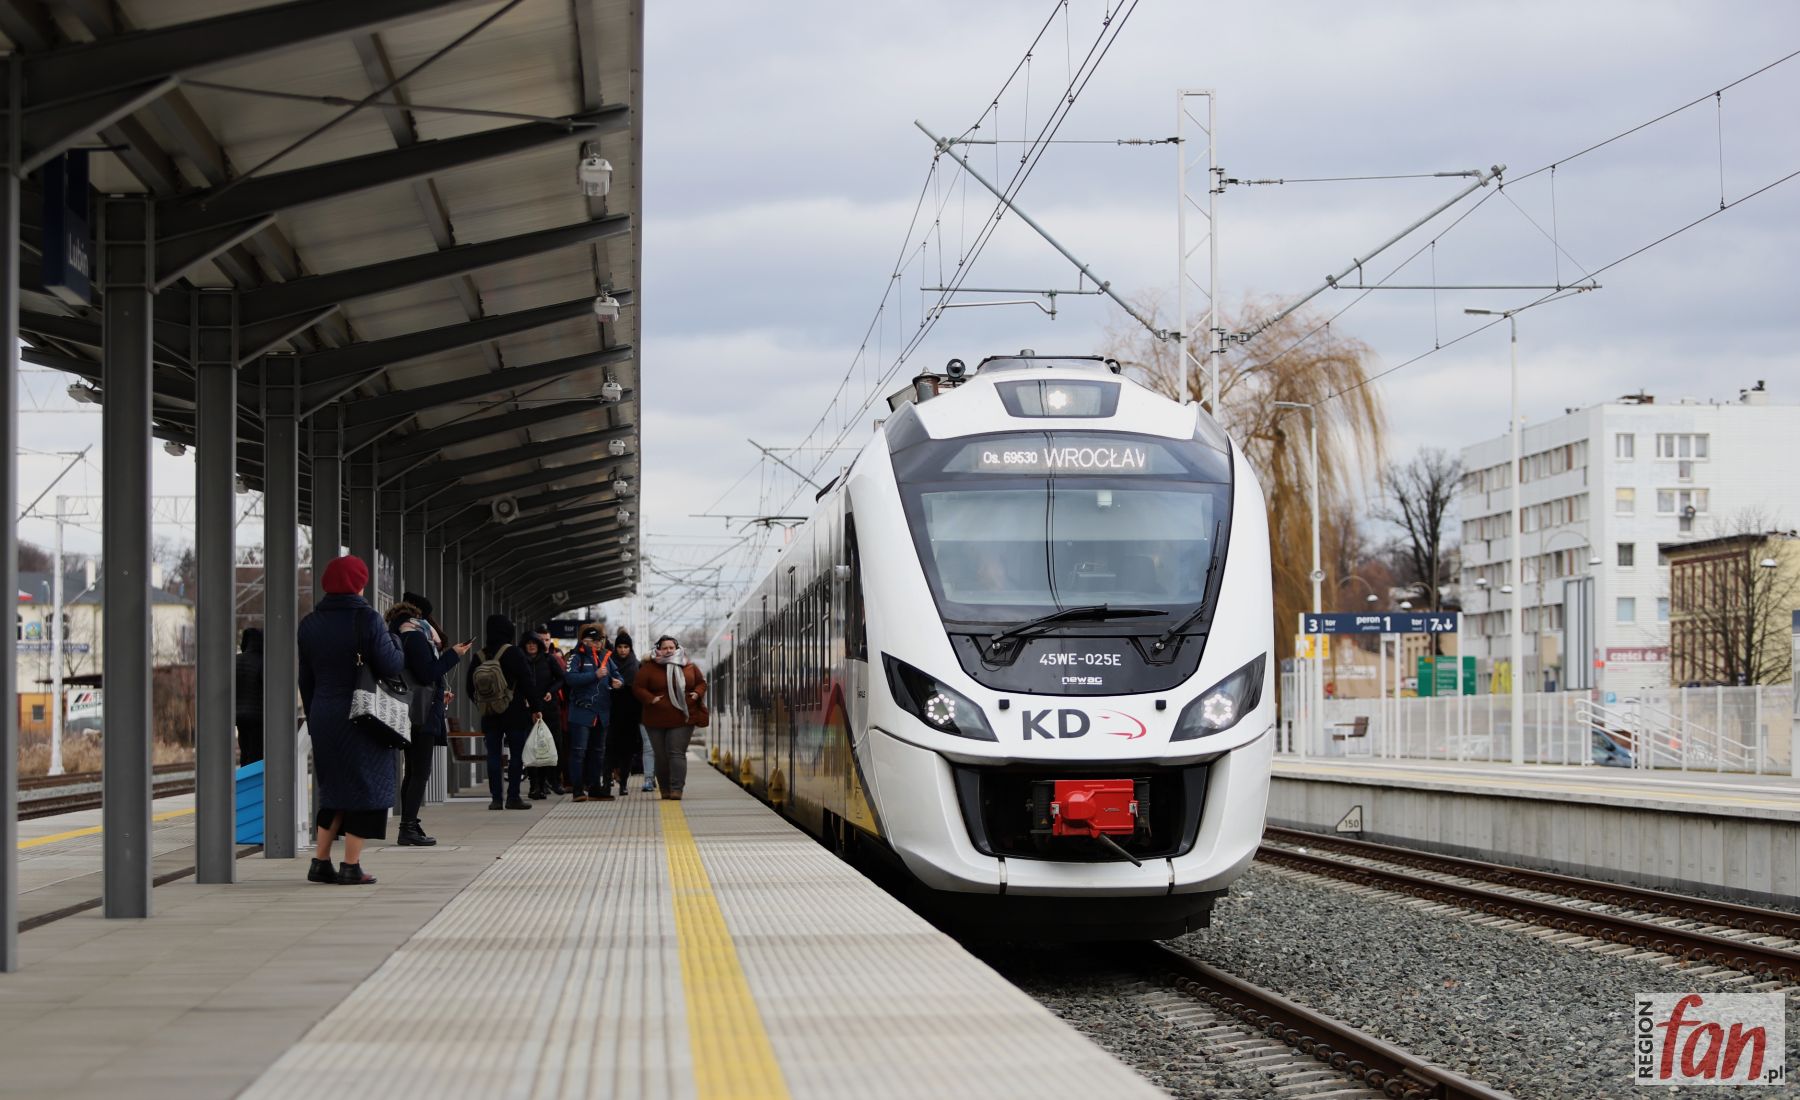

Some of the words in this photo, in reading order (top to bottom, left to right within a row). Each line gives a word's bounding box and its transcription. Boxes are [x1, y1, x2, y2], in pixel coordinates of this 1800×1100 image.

[69, 232, 89, 278] Lubin
[983, 451, 1000, 464] Os.
[1003, 451, 1038, 464] 69530
[1308, 619, 1318, 632] 3
[1356, 616, 1380, 625] peron
[1383, 616, 1391, 631] 1
[1039, 653, 1122, 666] 45WE-025E
[1022, 709, 1090, 740] KD
[1344, 819, 1360, 828] 150
